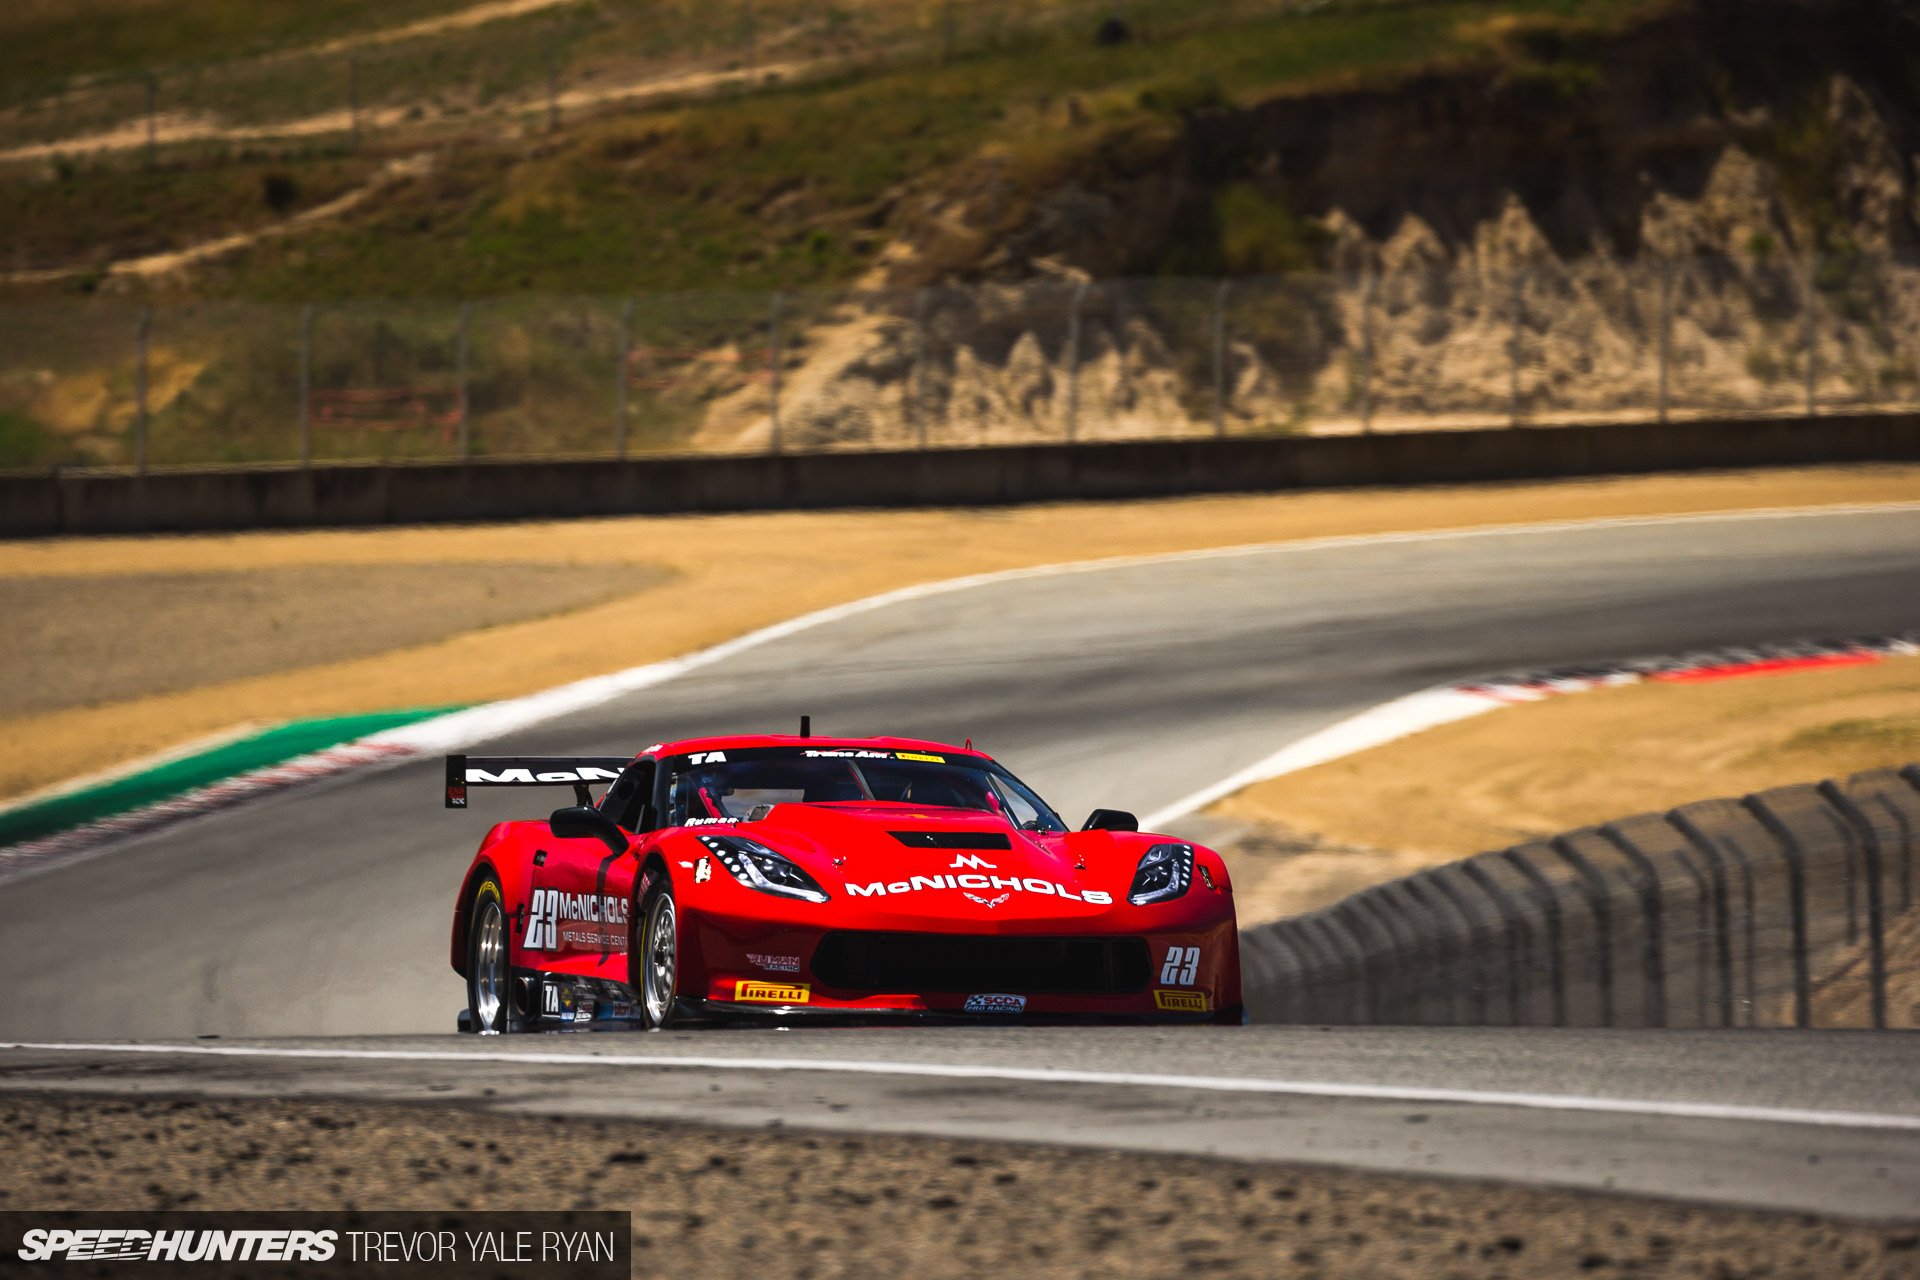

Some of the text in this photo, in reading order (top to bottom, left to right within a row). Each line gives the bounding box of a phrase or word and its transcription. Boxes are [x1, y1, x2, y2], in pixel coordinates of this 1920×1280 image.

[688, 751, 727, 765] TA
[855, 751, 888, 759] Am
[844, 874, 1114, 905] McNICHOLS
[560, 892, 629, 924] McNICHOLS
[523, 889, 558, 949] 23
[563, 931, 586, 943] METALS
[587, 933, 609, 945] SERVICE
[746, 954, 800, 966] RUMAN
[1161, 946, 1201, 986] 23
[545, 985, 559, 1012] TA
[741, 984, 803, 1000] PIRELLI
[1159, 991, 1204, 1009] PIRELLI
[983, 996, 1021, 1006] SCCA
